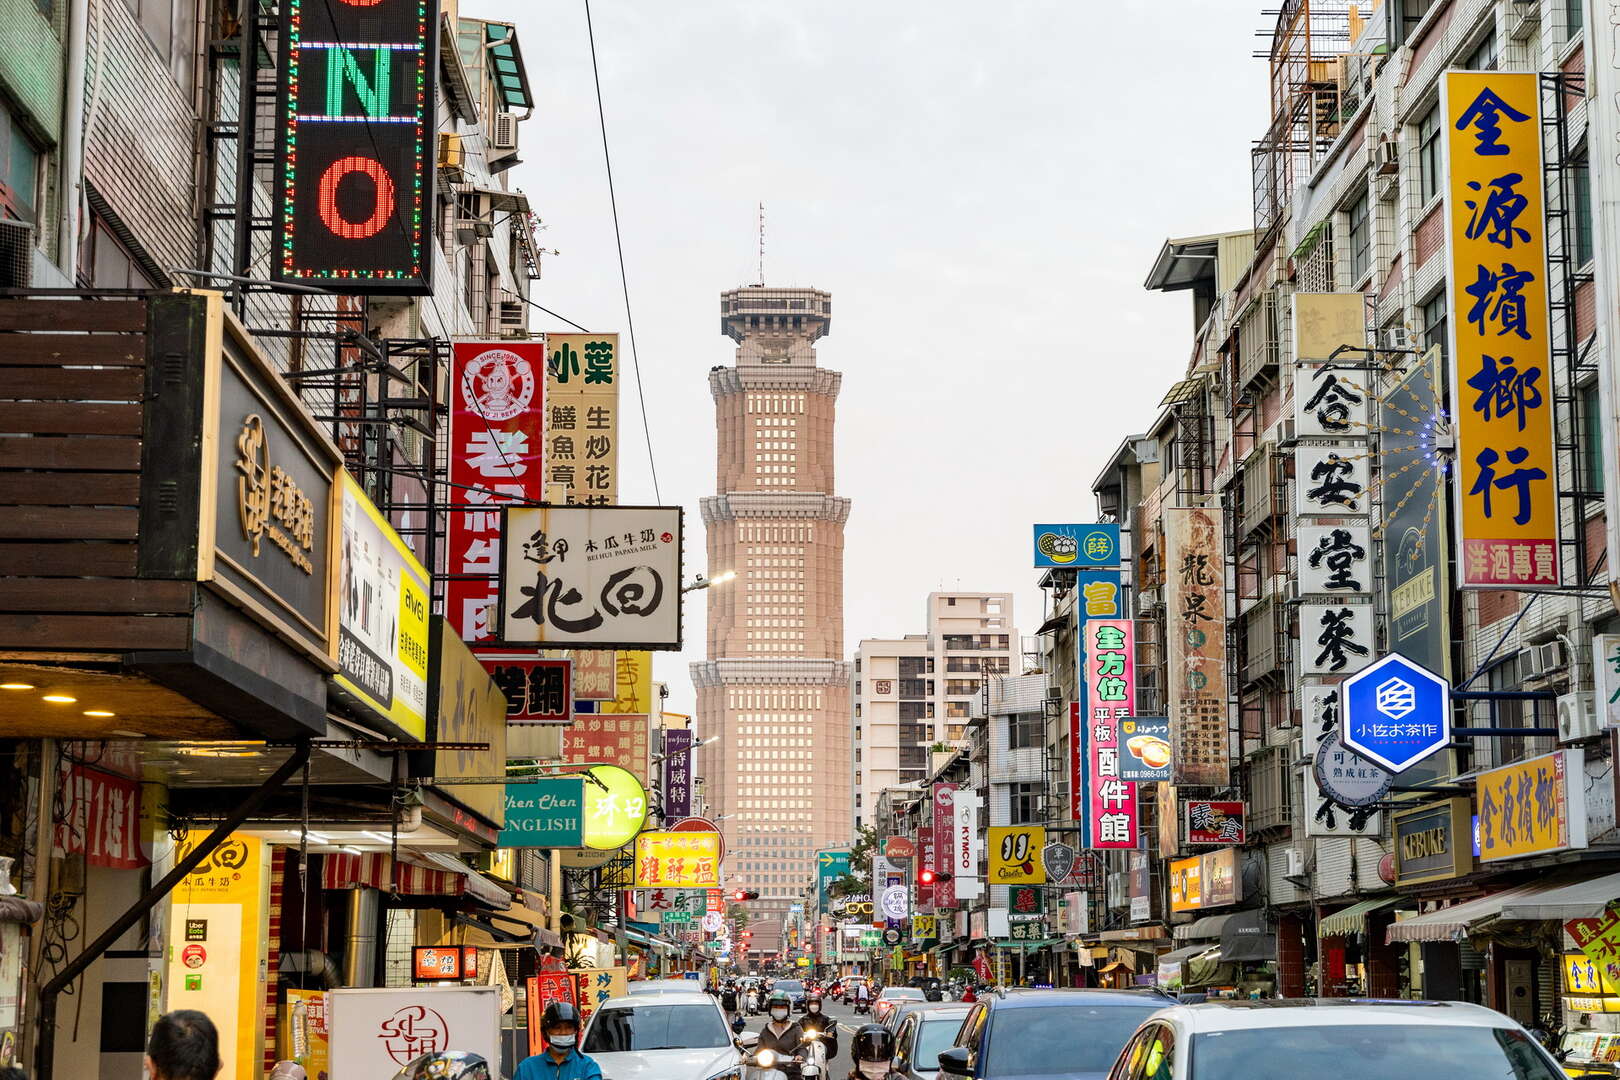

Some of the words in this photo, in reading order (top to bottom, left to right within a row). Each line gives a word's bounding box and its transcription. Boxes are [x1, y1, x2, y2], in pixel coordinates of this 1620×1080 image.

[1455, 87, 1547, 525] 金源檳榔行
[552, 341, 614, 385] 小葉
[551, 406, 577, 506] 鱔魚意
[522, 530, 568, 564] 逢甲
[585, 528, 655, 553] 木瓜牛奶
[640, 544, 657, 553] MILK
[1466, 543, 1556, 582] 洋酒專賣
[1393, 574, 1432, 616] KEBUKE
[1096, 626, 1127, 702] 全方位
[1094, 708, 1111, 742] 平板
[670, 750, 686, 803] 詩威特
[539, 794, 576, 810] Chen
[962, 826, 970, 869] KYMCO
[1403, 826, 1446, 861] KEBUKE
[1013, 923, 1041, 940] 西藥
